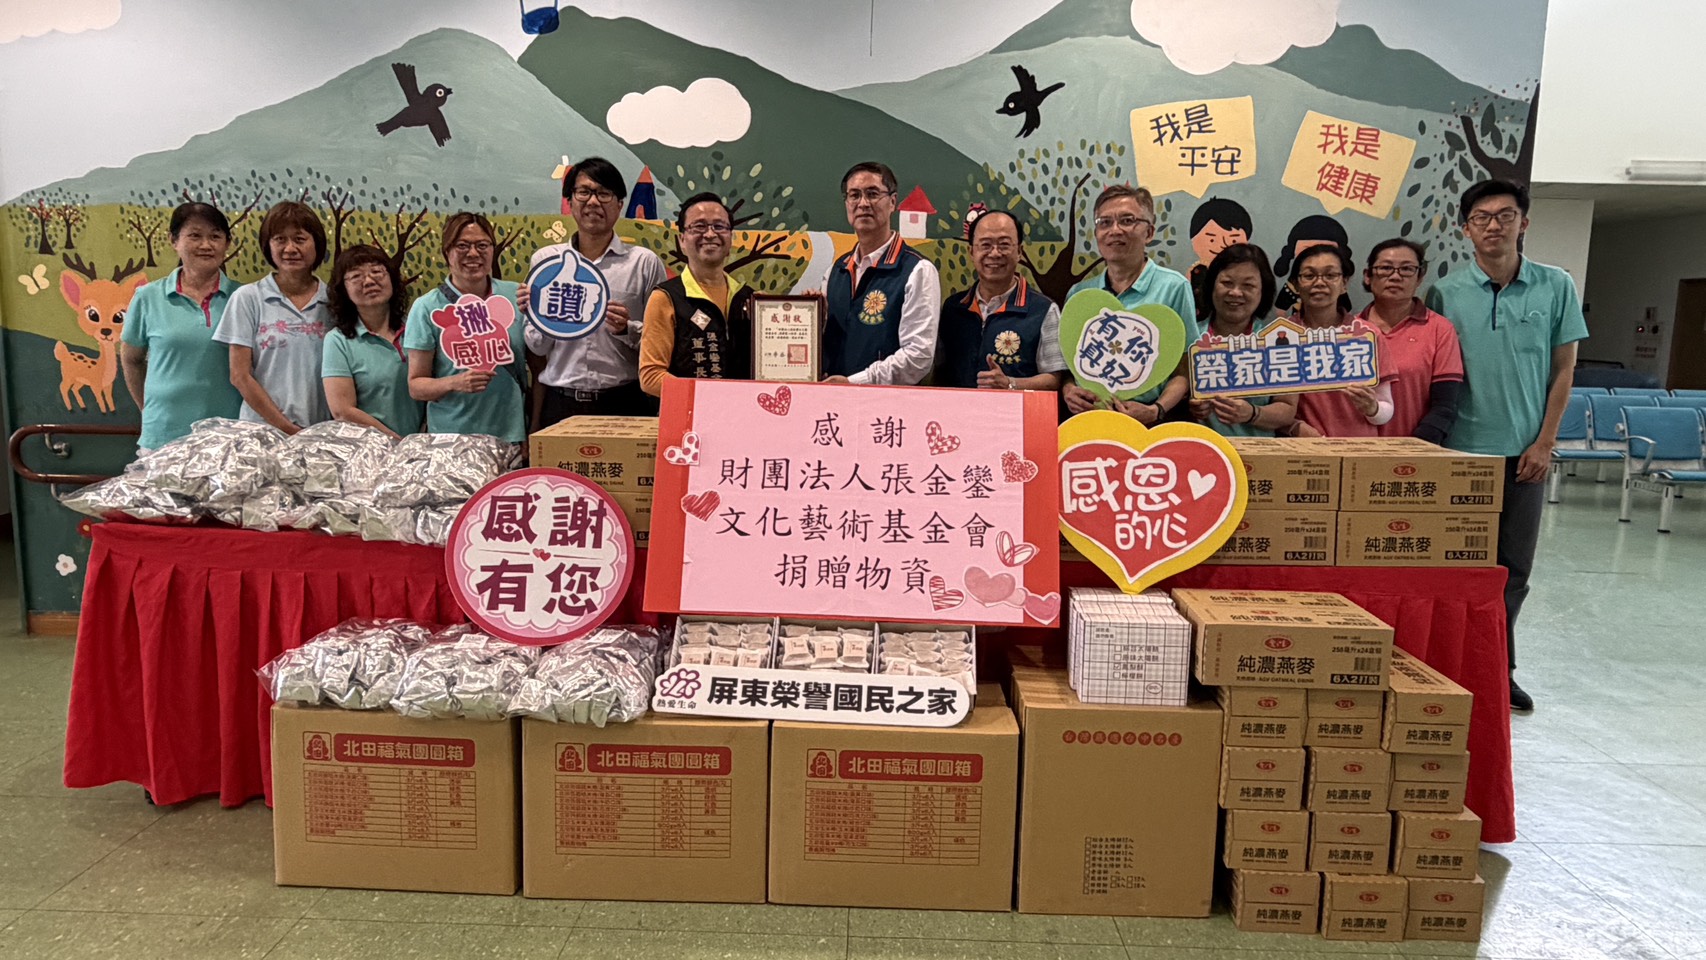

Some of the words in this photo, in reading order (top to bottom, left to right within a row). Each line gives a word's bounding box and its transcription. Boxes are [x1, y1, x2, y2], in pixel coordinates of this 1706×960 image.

[1150, 103, 1216, 146] 我是
[1317, 123, 1381, 160] 我是
[1178, 145, 1241, 176] 平安
[1316, 161, 1381, 205] 健康
[547, 281, 584, 320] 讚
[456, 302, 493, 336] 揪
[452, 338, 513, 366] 感心
[688, 337, 708, 378] 董事長
[706, 332, 722, 378] 張金鑾基
[1197, 342, 1372, 388] 榮家是我家
[810, 412, 907, 448] 感謝
[717, 456, 996, 499] 財團法人張金鑾
[1062, 457, 1182, 513] 感恩
[1369, 481, 1437, 498] 純濃燕麥
[481, 492, 607, 549] 感謝
[715, 504, 995, 548] 文化藝術基金會
[1115, 511, 1188, 550] 的心
[1364, 536, 1431, 553] 純濃燕麥
[773, 553, 932, 595] 捐贈物資
[475, 559, 602, 617] 有您
[1237, 655, 1315, 675] 純濃燕麥
[657, 698, 697, 709] 熱愛生命
[707, 676, 957, 716] 屏東榮譽國民之家
[1240, 723, 1287, 735] 純濃燕麥
[1317, 723, 1364, 735] 純濃燕麥
[1406, 729, 1453, 742] 純濃燕麥
[343, 739, 464, 761] 北田福氣團圓箱
[596, 750, 720, 769] 北田福氣團圓箱
[848, 756, 972, 777] 北田福氣團圓箱
[1240, 787, 1286, 799] 純濃燕麥
[1326, 789, 1372, 800] 純濃燕麥
[1404, 788, 1450, 800] 純濃燕麥
[1243, 847, 1289, 859] 純濃燕麥
[1328, 849, 1374, 861] 純濃燕麥
[1416, 854, 1464, 867] 純濃燕麥
[1256, 909, 1302, 921] 純濃燕麥
[1341, 918, 1387, 929] 純濃燕麥
[1421, 917, 1467, 928] 純濃燕麥
